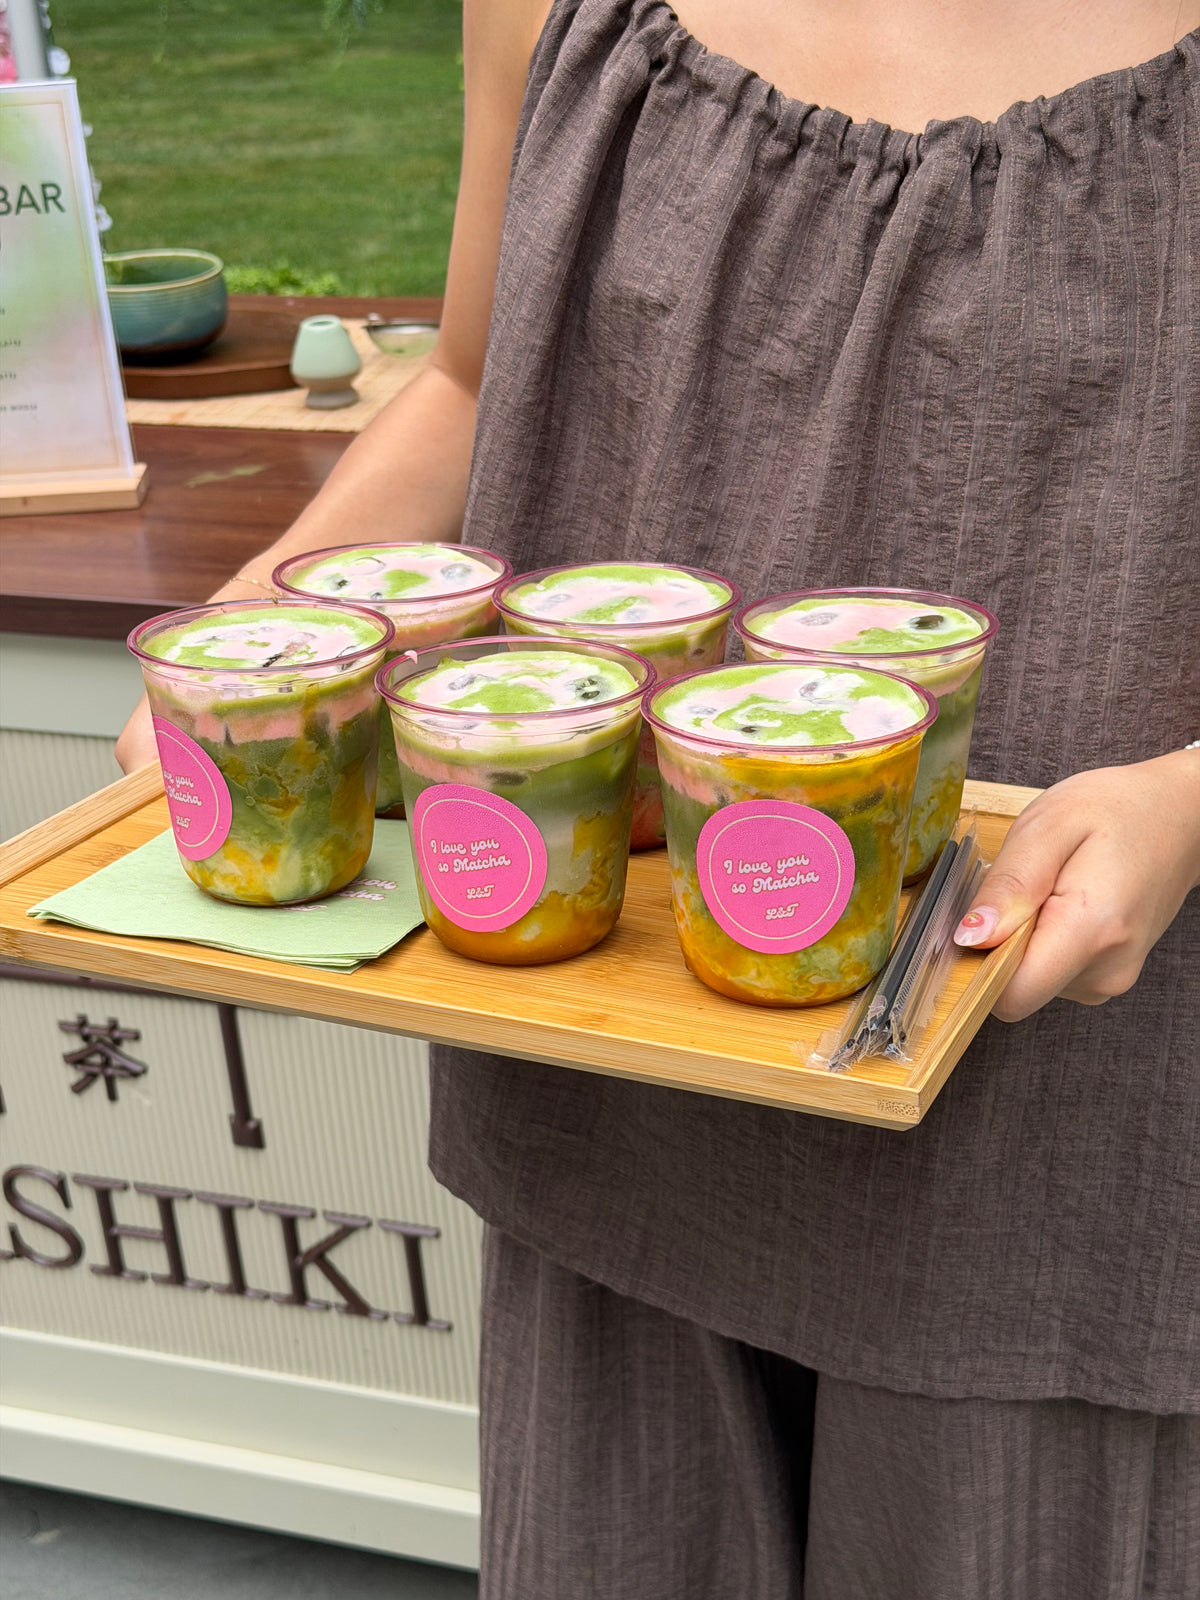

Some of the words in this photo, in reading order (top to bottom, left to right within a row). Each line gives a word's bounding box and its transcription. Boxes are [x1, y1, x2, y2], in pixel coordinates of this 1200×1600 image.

[0, 183, 66, 216] BAR
[175, 775, 194, 788] you
[430, 839, 437, 854] I
[440, 840, 467, 855] love
[470, 838, 500, 856] you
[438, 861, 449, 873] so
[453, 854, 511, 873] Matcha
[723, 859, 733, 874] I
[738, 859, 772, 874] love
[776, 854, 810, 874] you
[466, 885, 495, 899] L&T
[731, 882, 747, 894] so
[751, 871, 820, 894] Matcha
[765, 903, 799, 920] L&T
[57, 1013, 148, 1103] 茶
[0, 1163, 454, 1333] SHIKI
